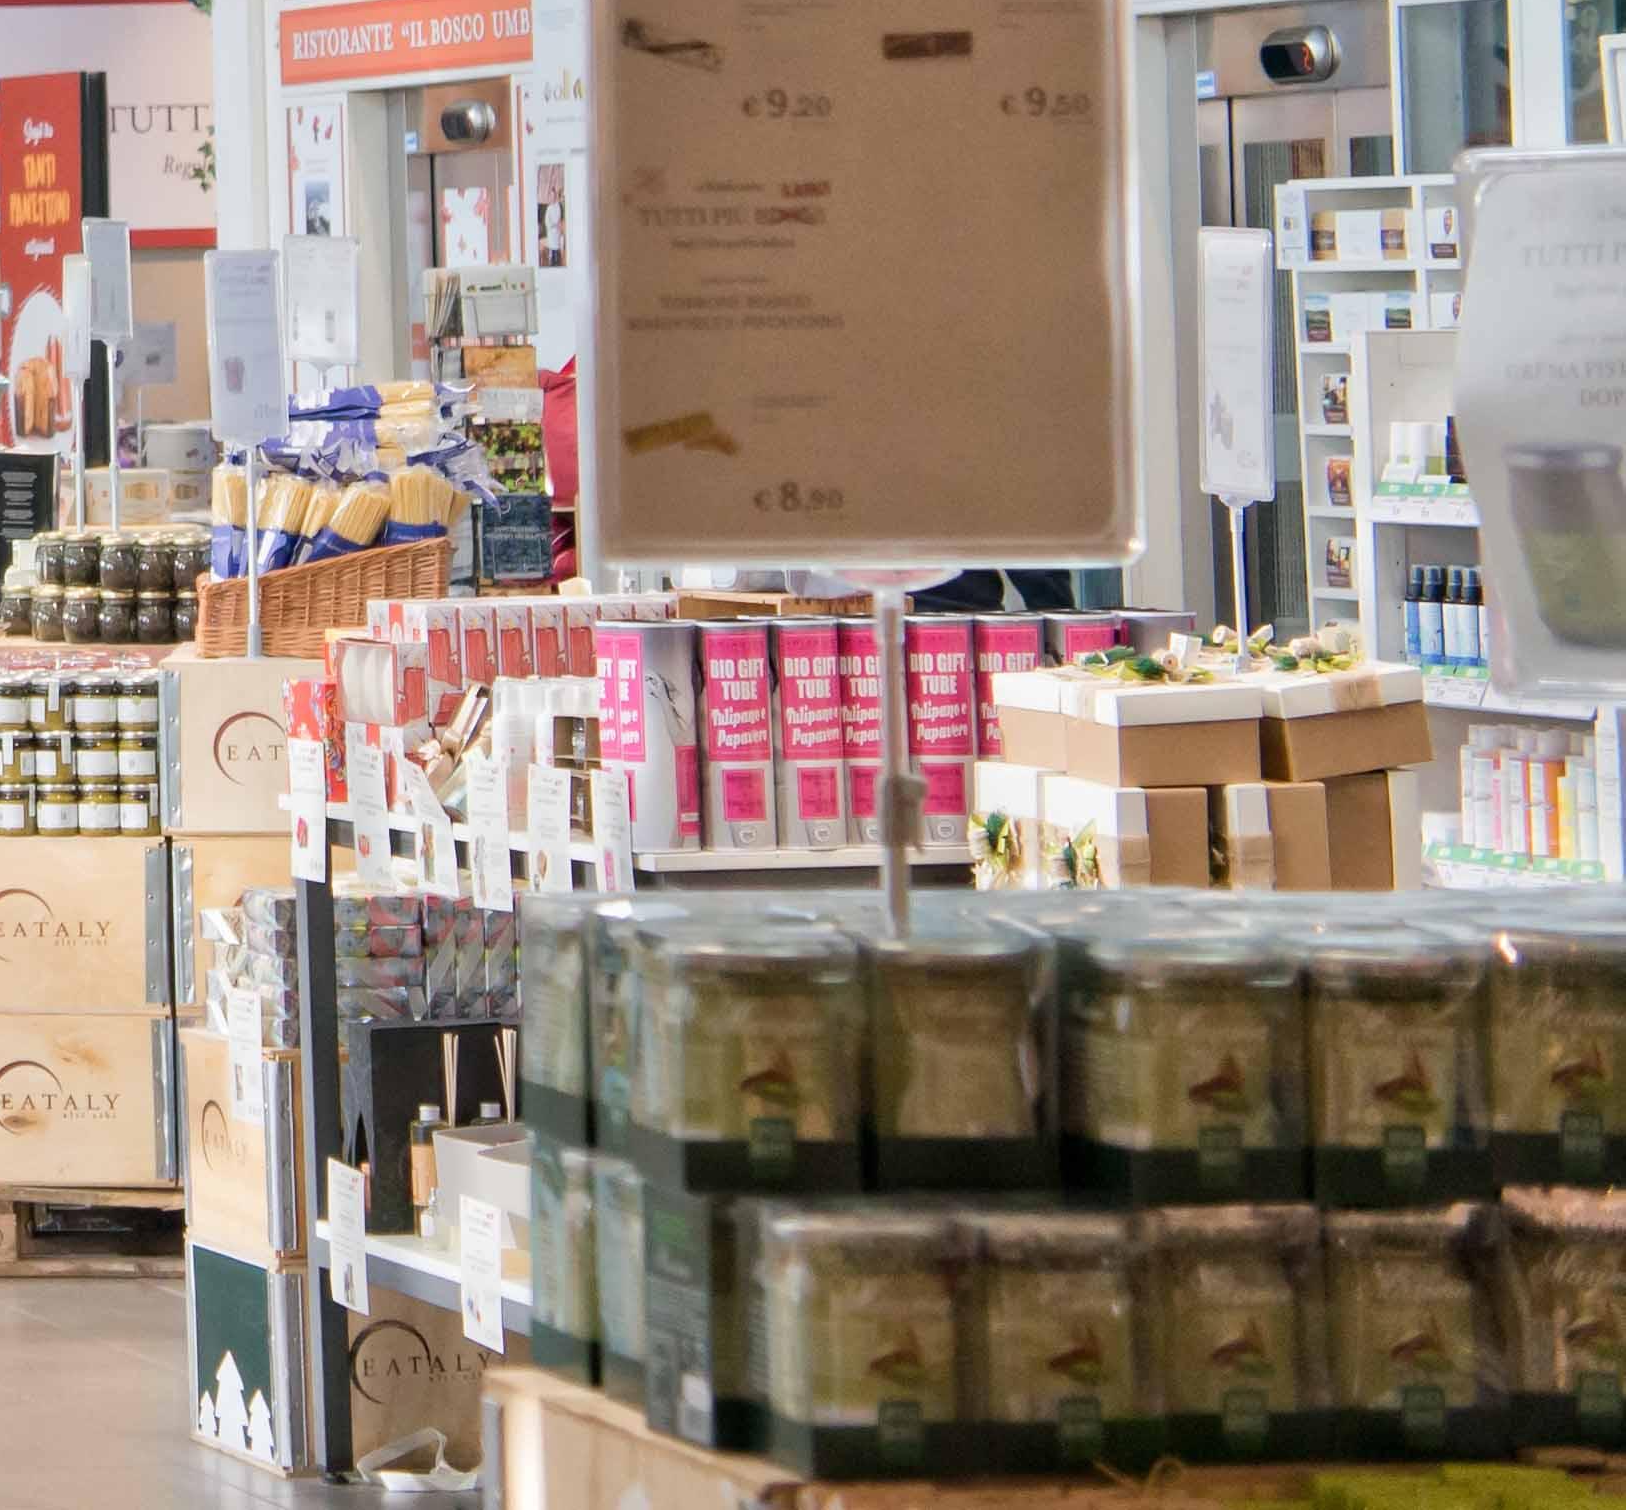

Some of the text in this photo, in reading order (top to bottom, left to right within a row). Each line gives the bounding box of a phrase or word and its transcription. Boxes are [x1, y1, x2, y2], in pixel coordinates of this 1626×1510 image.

[292, 21, 394, 61] RISTORANTE
[430, 12, 485, 47] BOSCO
[709, 659, 735, 678] BIO
[784, 657, 810, 678] BIO
[910, 653, 966, 674] BIO GIFT
[721, 681, 758, 701] TUBE
[796, 679, 831, 699] TUBE
[920, 675, 958, 695] TUBE
[0, 1093, 122, 1112] EATALY
[363, 1351, 493, 1378] EATALY
